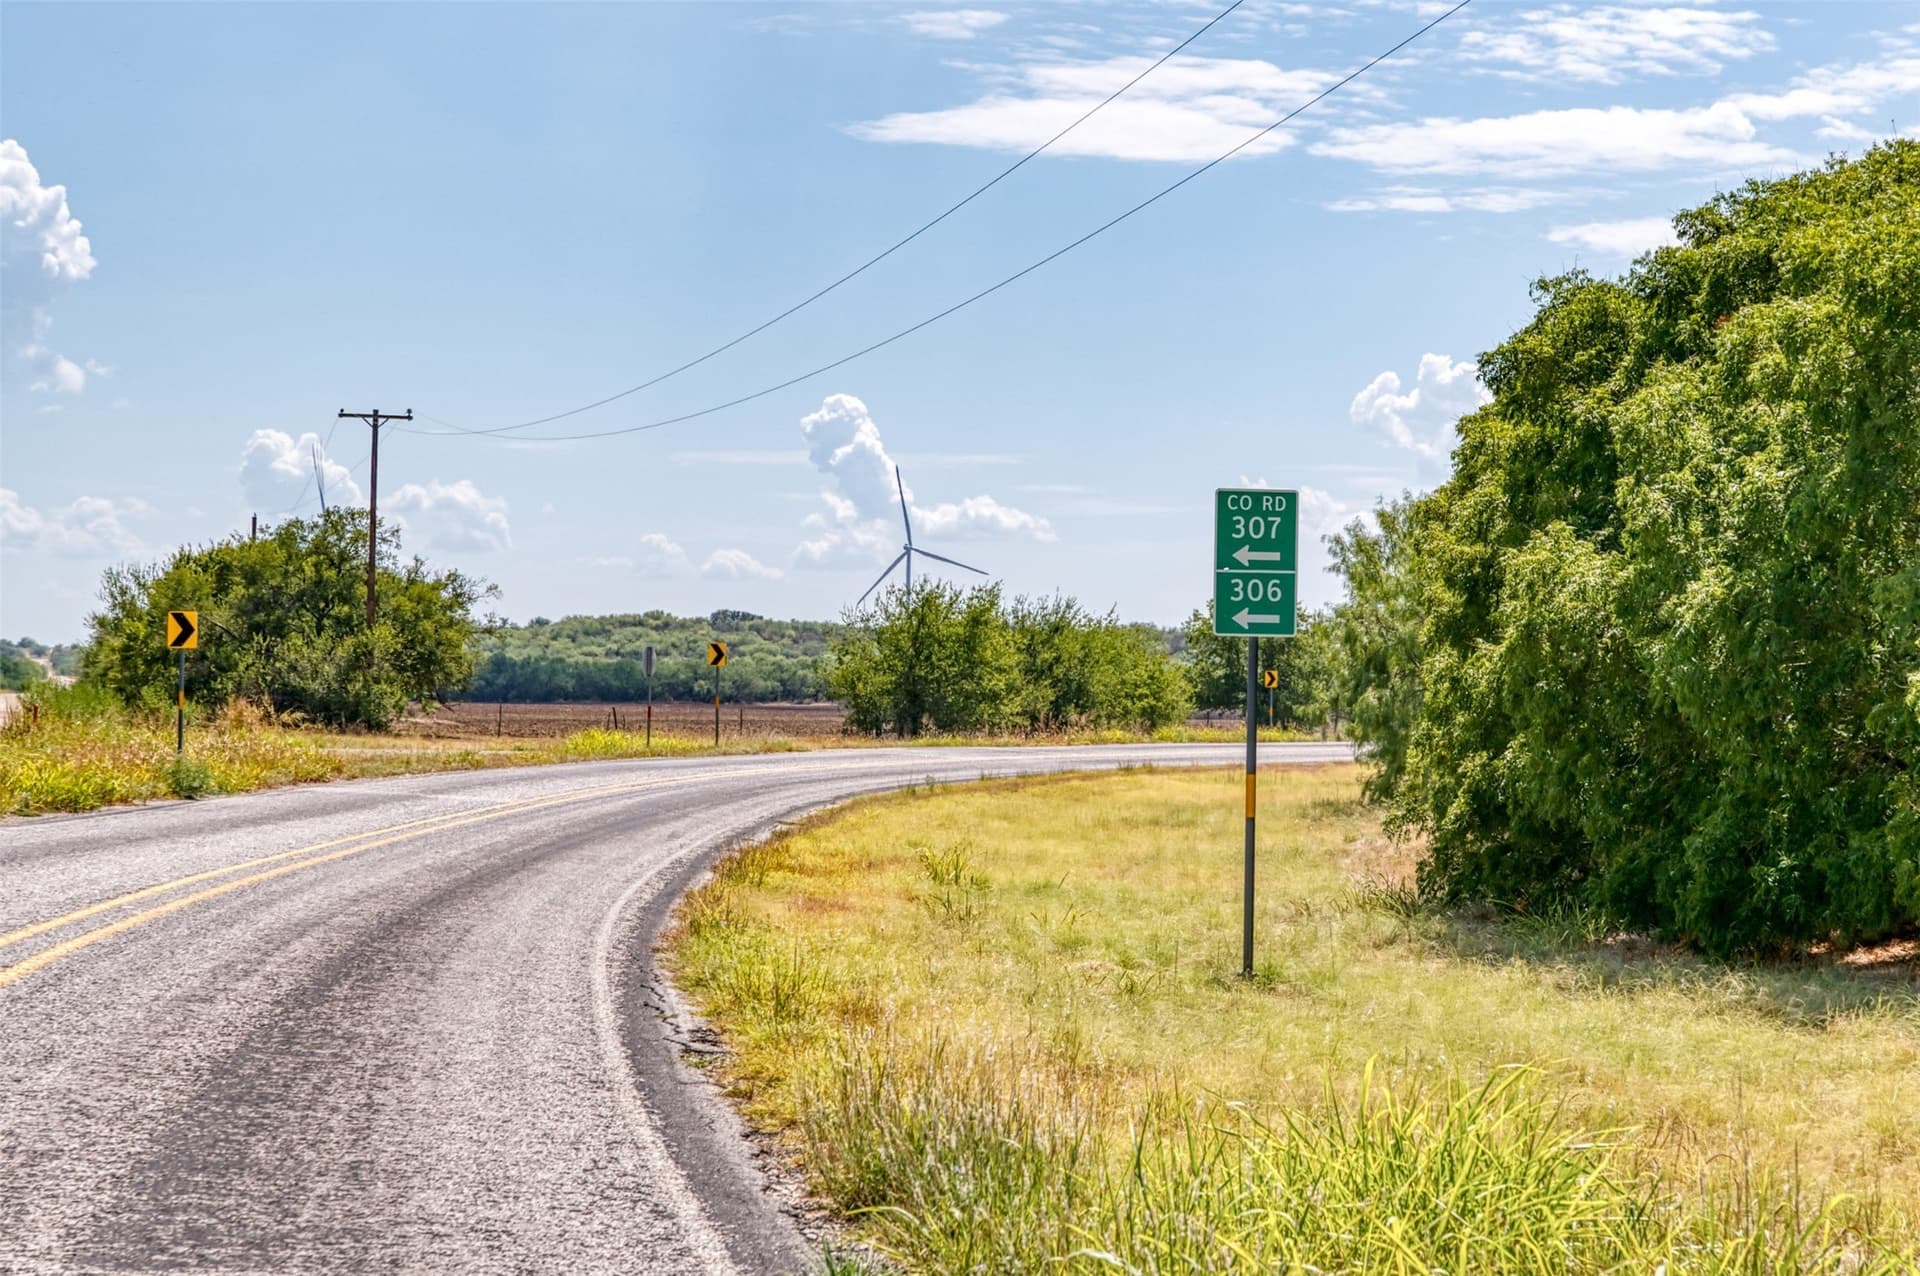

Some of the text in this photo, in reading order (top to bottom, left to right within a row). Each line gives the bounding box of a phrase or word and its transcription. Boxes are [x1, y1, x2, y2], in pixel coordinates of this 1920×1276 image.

[1227, 495, 1287, 511] CO RD
[1231, 515, 1281, 539] 307
[1230, 578, 1282, 602] 306
